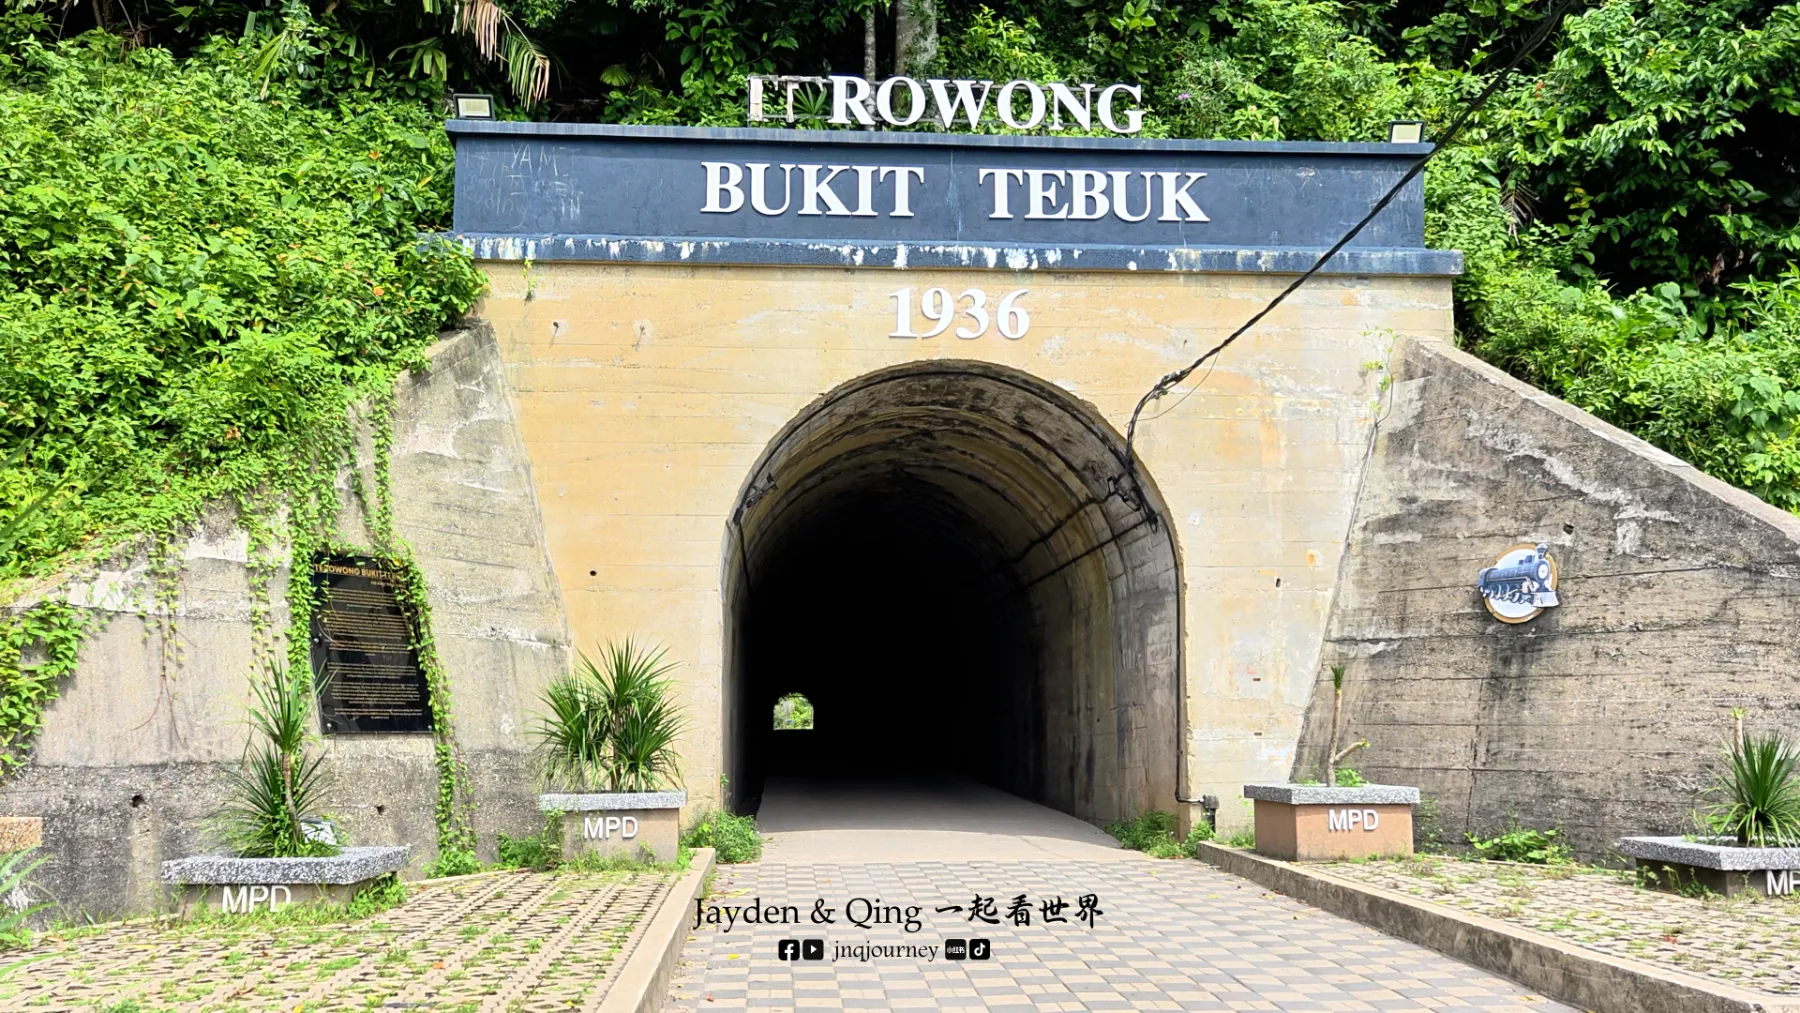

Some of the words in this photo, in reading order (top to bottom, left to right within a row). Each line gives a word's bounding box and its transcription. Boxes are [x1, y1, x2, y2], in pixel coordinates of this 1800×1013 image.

[700, 160, 925, 217] BUKIT
[978, 168, 1209, 223] TEBUK
[889, 287, 1030, 340] 1936
[584, 816, 638, 839] MPD
[1328, 809, 1379, 831] MPD
[222, 885, 292, 914] MPD
